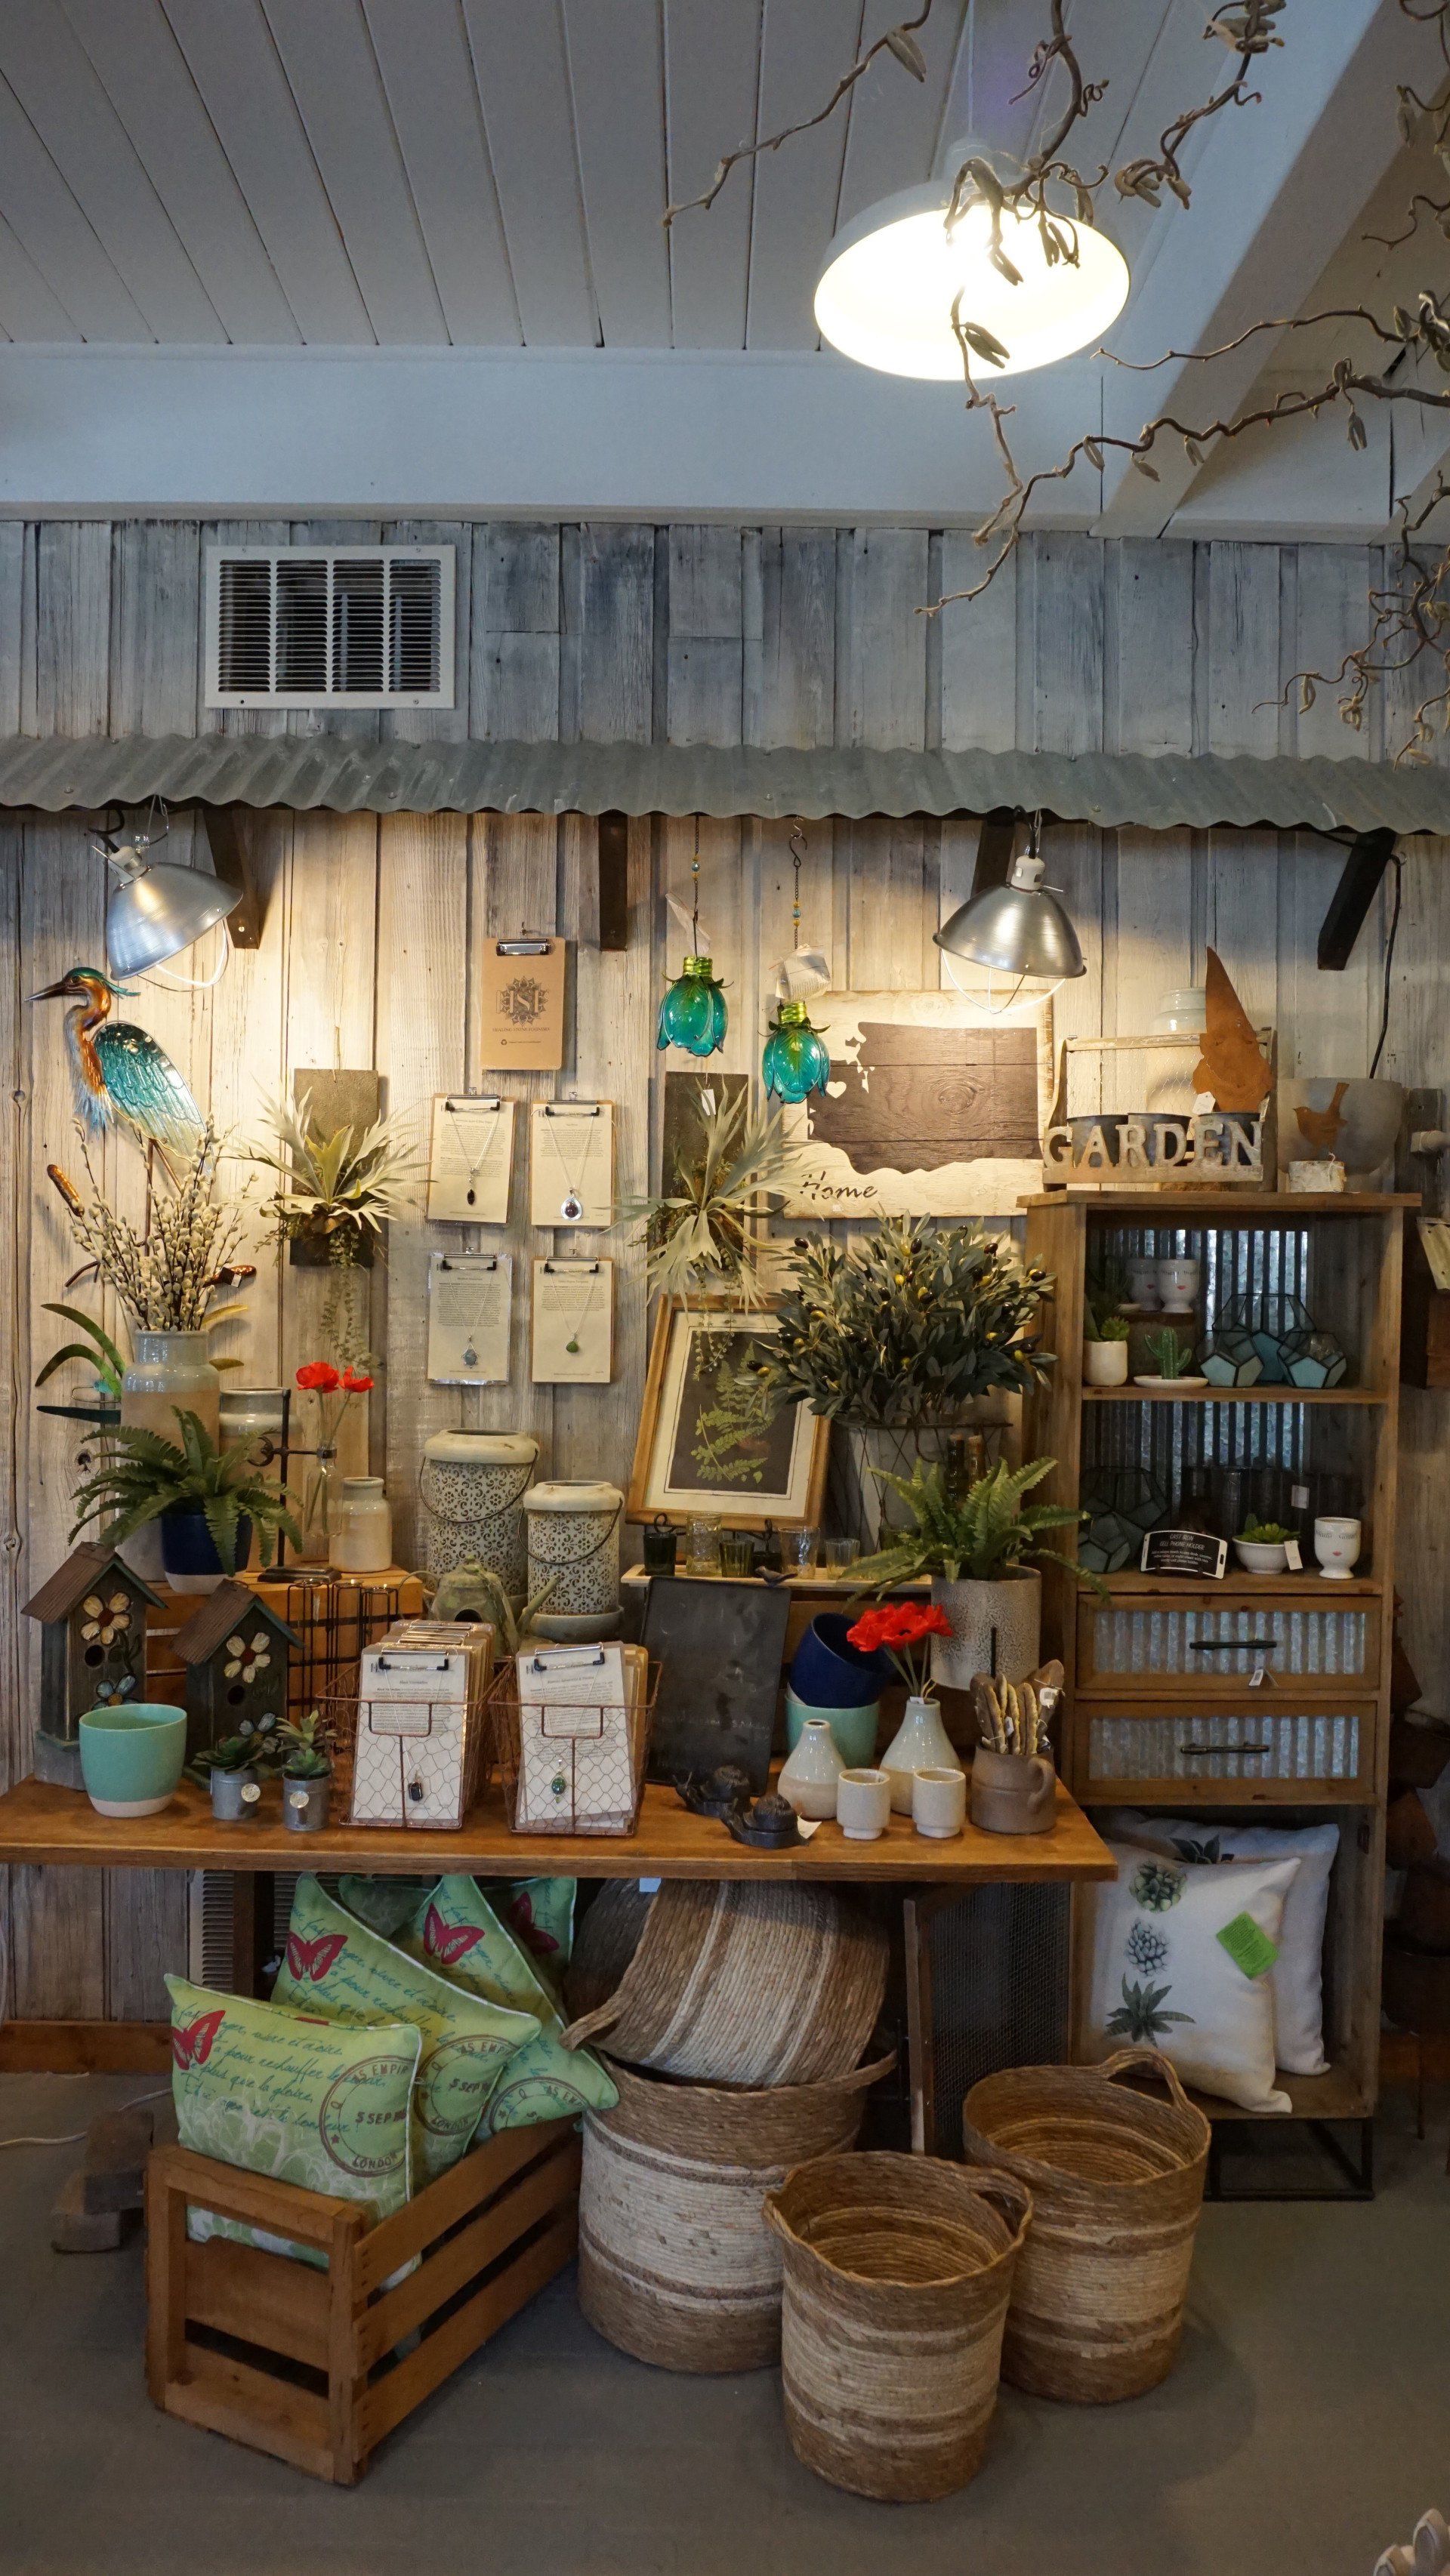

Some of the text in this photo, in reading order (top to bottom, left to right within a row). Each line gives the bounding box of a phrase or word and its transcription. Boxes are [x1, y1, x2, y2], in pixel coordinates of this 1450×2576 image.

[1043, 1120, 1263, 1169] GARDEN
[800, 1170, 878, 1200] Home
[1186, 1542, 1205, 1551] HOLDER
[366, 2111, 392, 2125] SEP
[352, 2152, 397, 2169] LONDON
